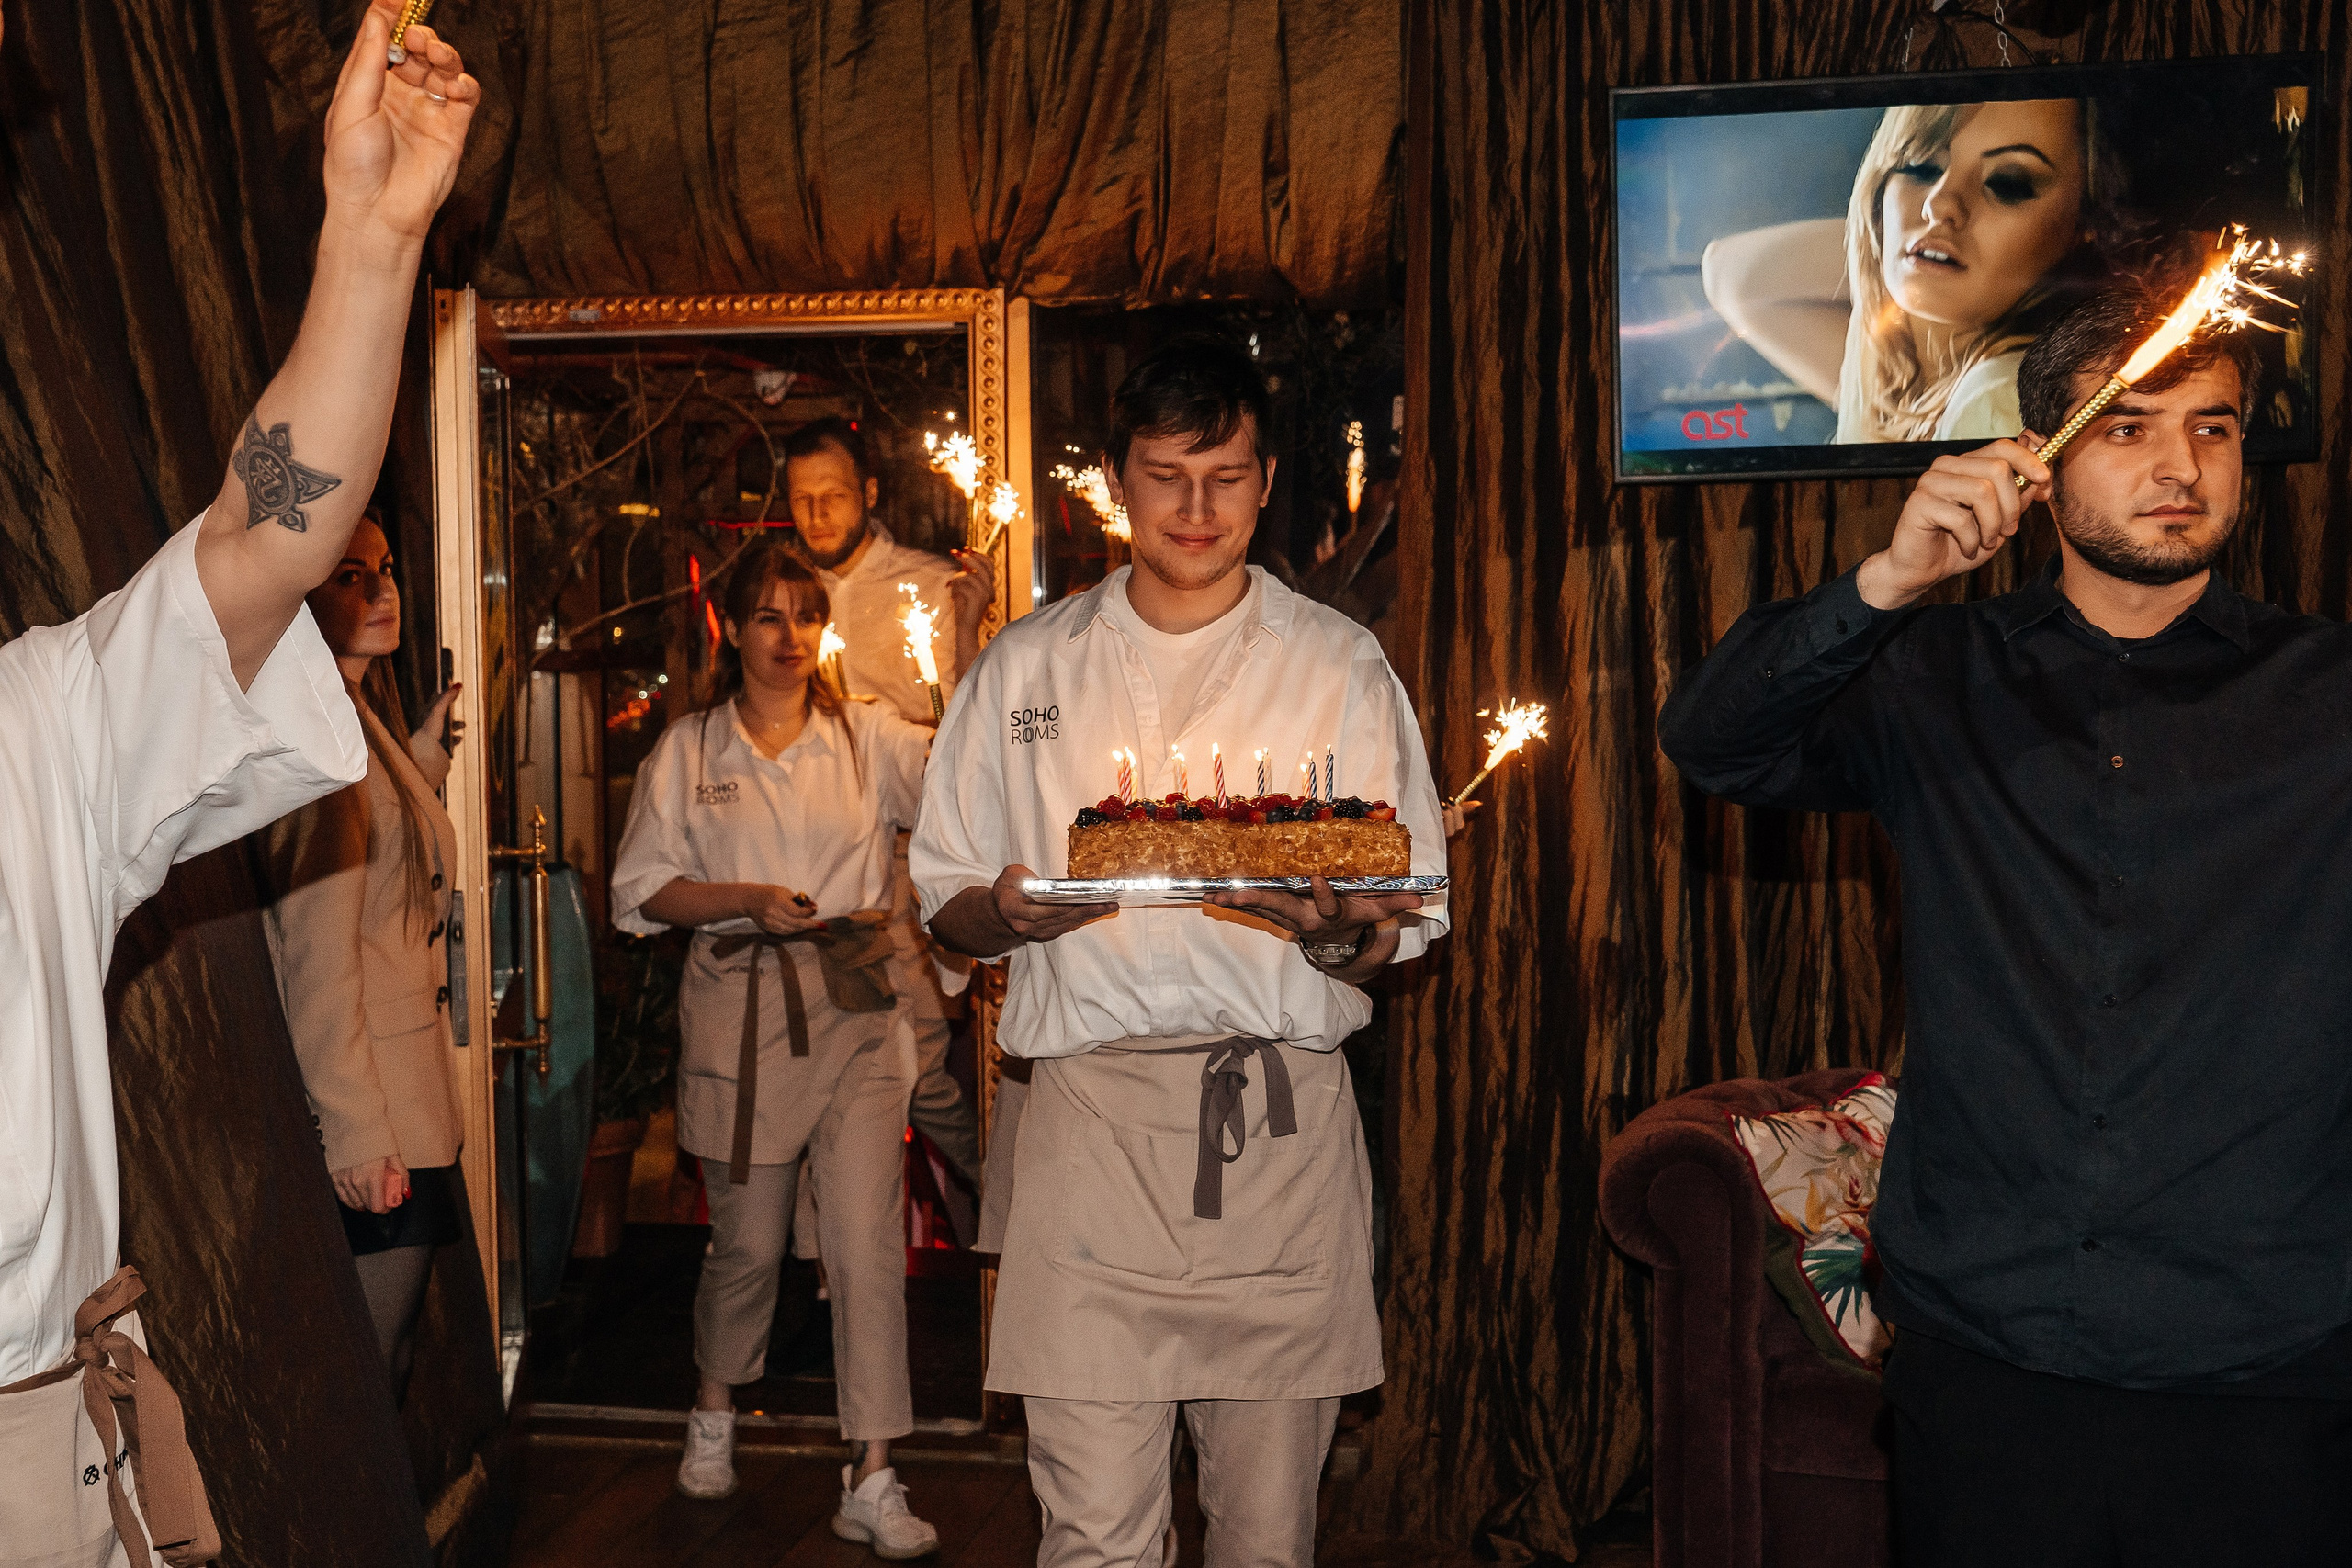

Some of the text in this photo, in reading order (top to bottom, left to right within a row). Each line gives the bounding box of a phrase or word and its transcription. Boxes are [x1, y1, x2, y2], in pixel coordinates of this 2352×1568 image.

[1681, 402, 1749, 442] ast
[1010, 705, 1059, 727] SOHO
[695, 781, 738, 795] SOHO
